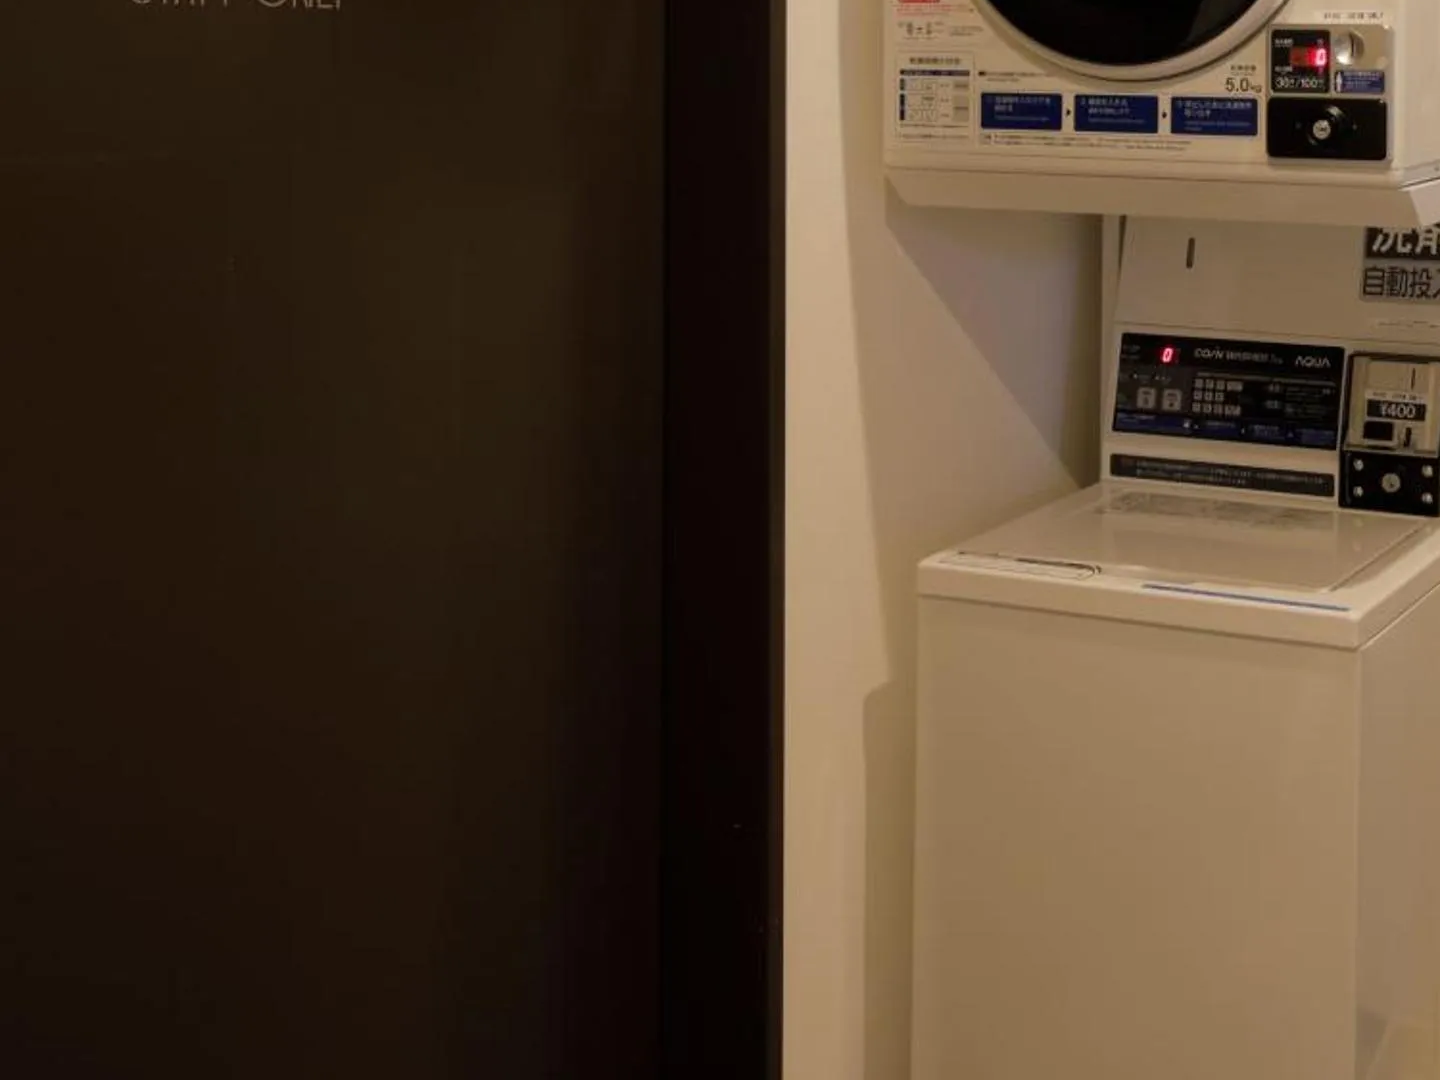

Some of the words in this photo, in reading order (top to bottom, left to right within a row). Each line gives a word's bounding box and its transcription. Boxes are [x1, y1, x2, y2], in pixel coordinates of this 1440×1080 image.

[1315, 48, 1328, 67] 0
[1162, 347, 1173, 363] 0
[1295, 355, 1330, 368] AQUA
